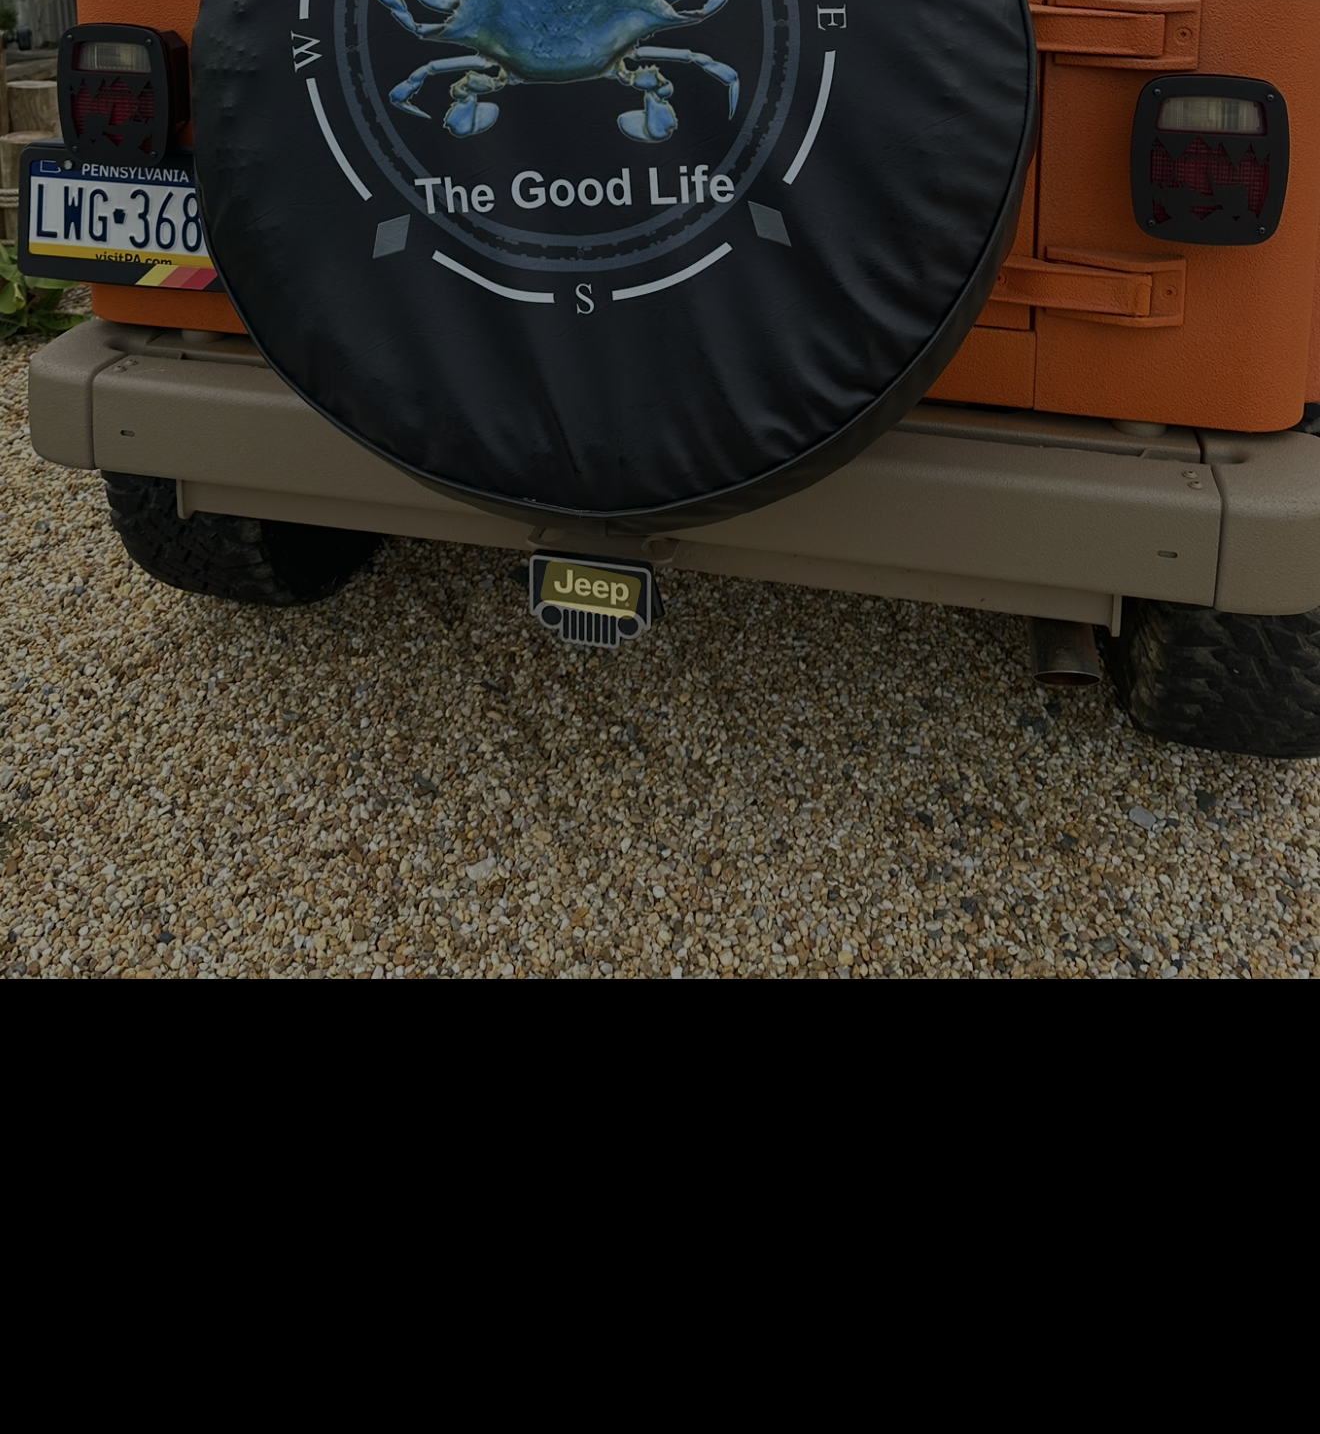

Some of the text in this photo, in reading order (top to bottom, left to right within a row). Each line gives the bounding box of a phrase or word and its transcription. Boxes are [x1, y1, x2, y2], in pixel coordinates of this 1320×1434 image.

[816, 4, 847, 31] E
[291, 31, 321, 73] W
[81, 162, 190, 183] PENNSYLVANIA
[414, 164, 735, 215] The Good Life
[575, 283, 595, 314] S
[553, 569, 629, 605] Jeep
